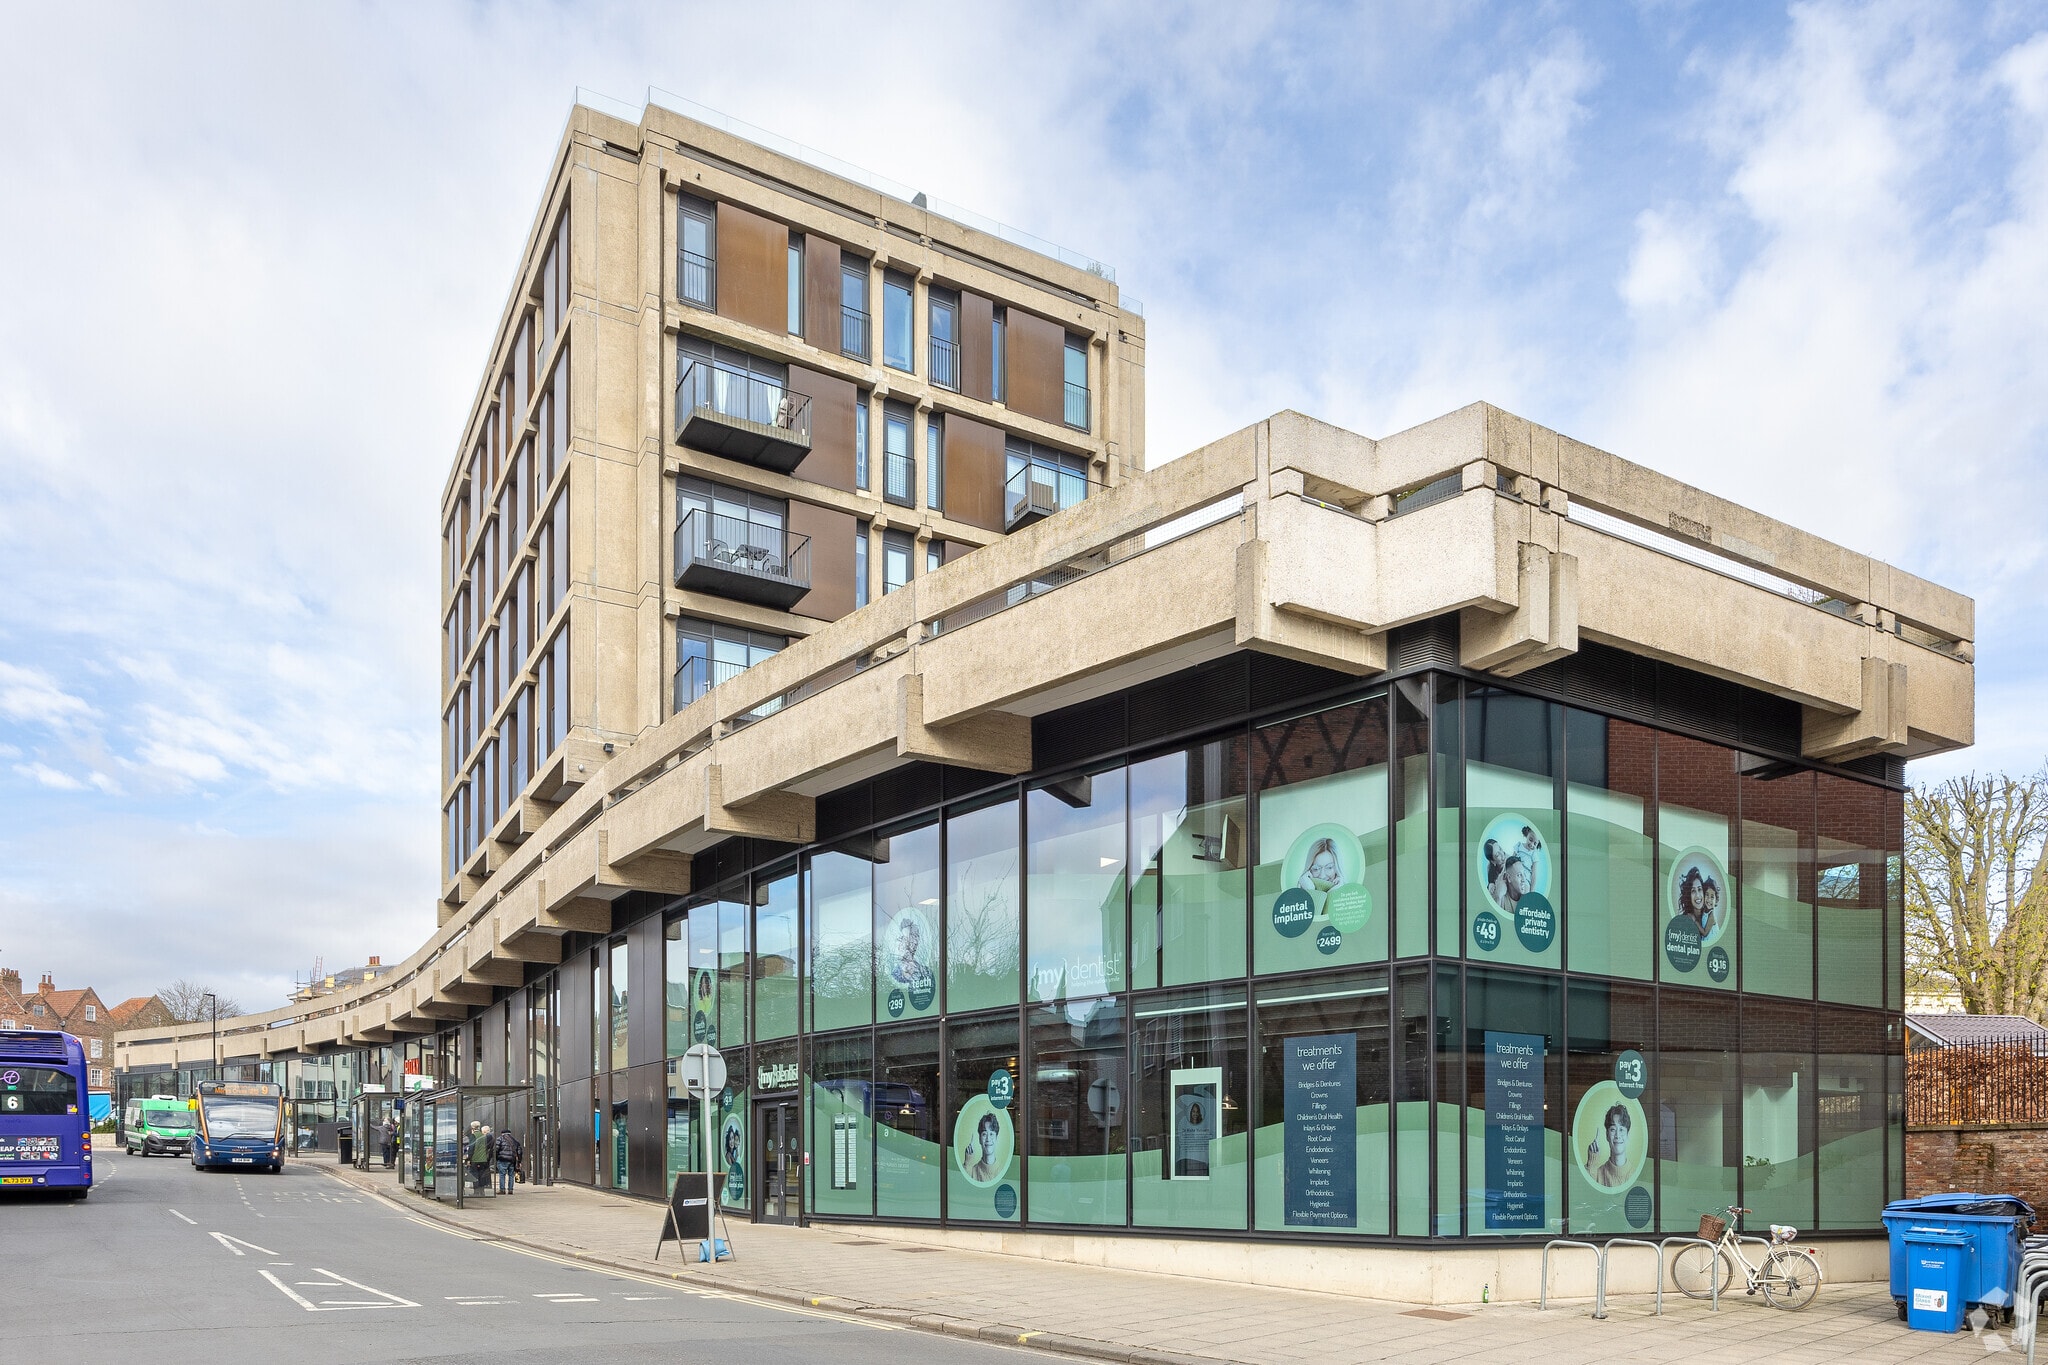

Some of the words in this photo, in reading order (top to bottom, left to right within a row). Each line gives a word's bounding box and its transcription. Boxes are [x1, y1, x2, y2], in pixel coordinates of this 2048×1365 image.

[1280, 900, 1308, 914] dental
[1274, 911, 1313, 925] implants
[1519, 907, 1551, 920] affordable
[1525, 917, 1547, 928] private
[1476, 923, 1496, 940] £49
[1521, 925, 1549, 939] dentistry
[1317, 936, 1341, 947] £2499
[1667, 942, 1686, 953] dental
[1687, 945, 1700, 956] plan
[912, 977, 932, 989] teeth
[1297, 1044, 1342, 1057] treatments
[1496, 1042, 1534, 1056] treatments
[1302, 1062, 1315, 1071] we
[1316, 1057, 1337, 1070] offer
[1501, 1060, 1511, 1069] we
[1513, 1057, 1529, 1070] offer
[1620, 1061, 1632, 1071] pay
[1625, 1070, 1631, 1080] in
[1298, 1081, 1315, 1089] Bridges
[1497, 1079, 1512, 1088] Bridges
[1516, 1080, 1533, 1088] Dentures
[261, 1085, 269, 1095] 9
[996, 1086, 1001, 1094] in
[7, 1096, 18, 1109] 6
[1312, 1102, 1327, 1111] Fillings
[1509, 1102, 1521, 1110] Fillings
[1327, 1112, 1343, 1120] Health
[1303, 1125, 1316, 1133] Inlays
[1321, 1124, 1336, 1132] Onlays
[1504, 1146, 1527, 1154] Endodontics
[1308, 1168, 1331, 1176] Whitening
[1506, 1168, 1525, 1177] Whitening
[1306, 1189, 1334, 1197] Orthodontics
[1507, 1202, 1524, 1210] Hygienist
[1293, 1210, 1310, 1218] Flexible
[1310, 1211, 1330, 1220] Payment
[1331, 1212, 1348, 1220] Options
[1507, 1213, 1523, 1221] Payment
[1524, 1213, 1538, 1221] Options
